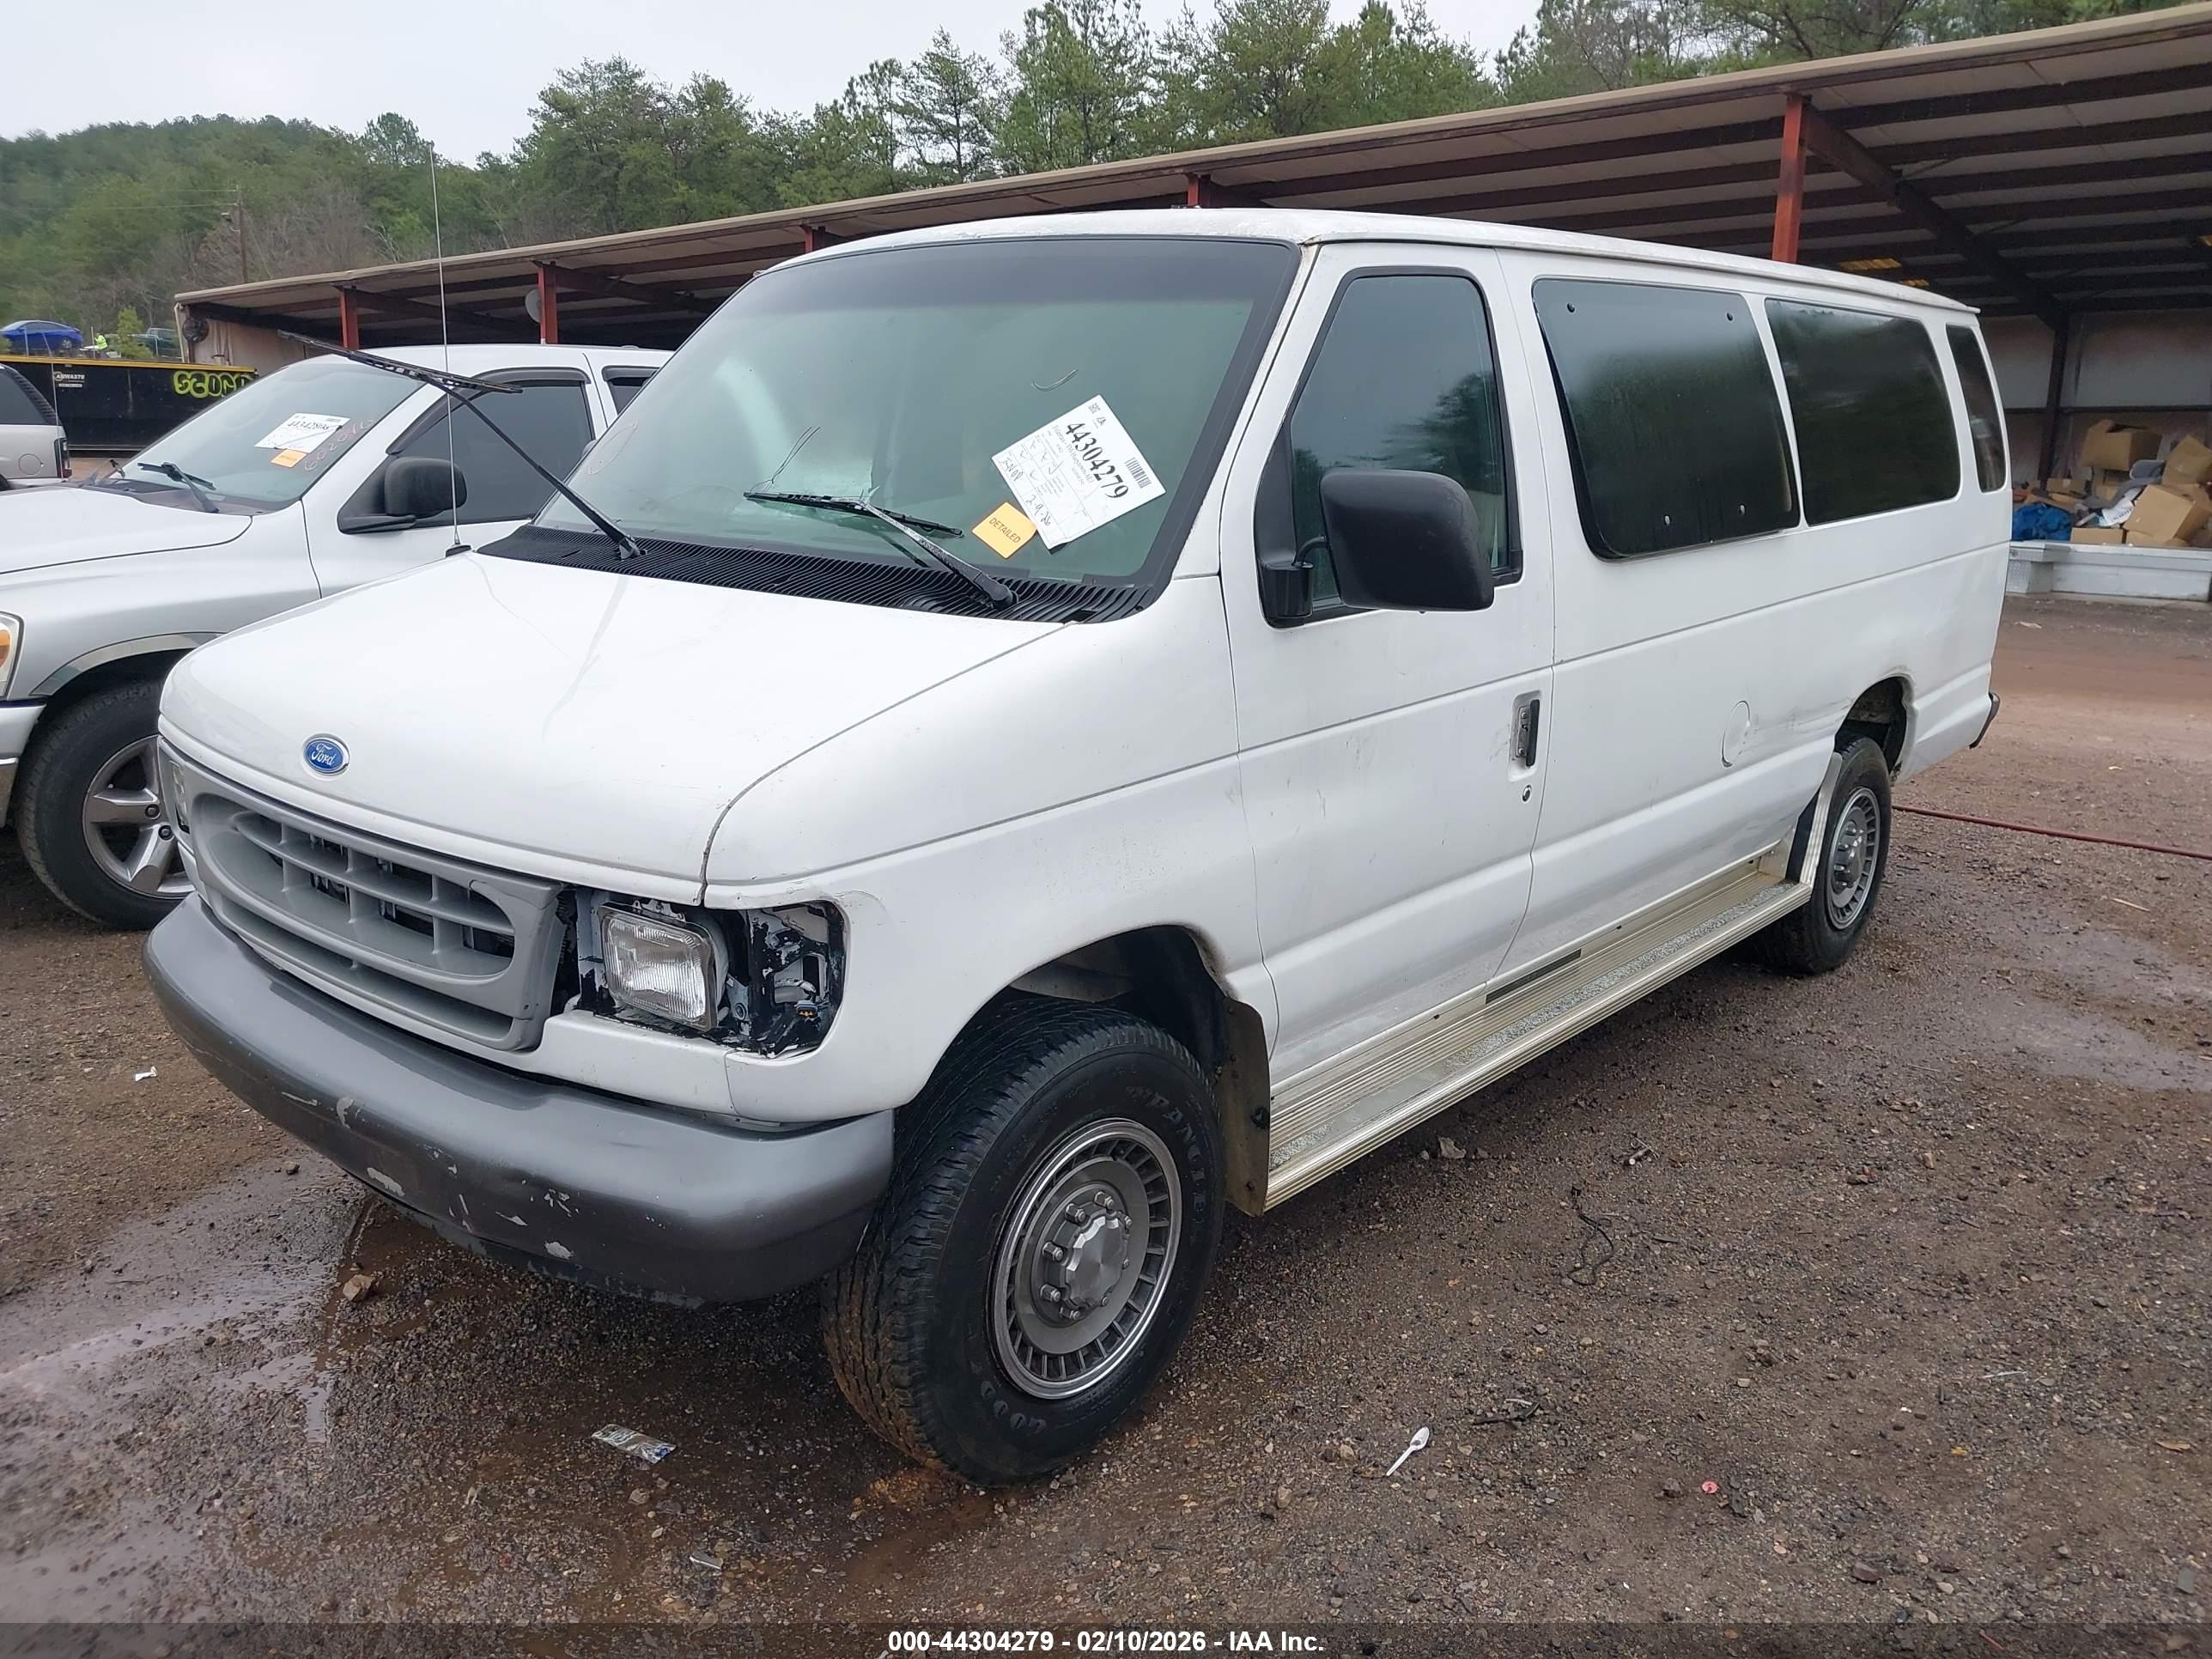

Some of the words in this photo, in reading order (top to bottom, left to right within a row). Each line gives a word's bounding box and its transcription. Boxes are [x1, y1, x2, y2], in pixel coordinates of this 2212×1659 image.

[1066, 422, 1129, 499] 44304279
[988, 516, 1021, 544] DETAILED
[311, 743, 337, 765] Ford
